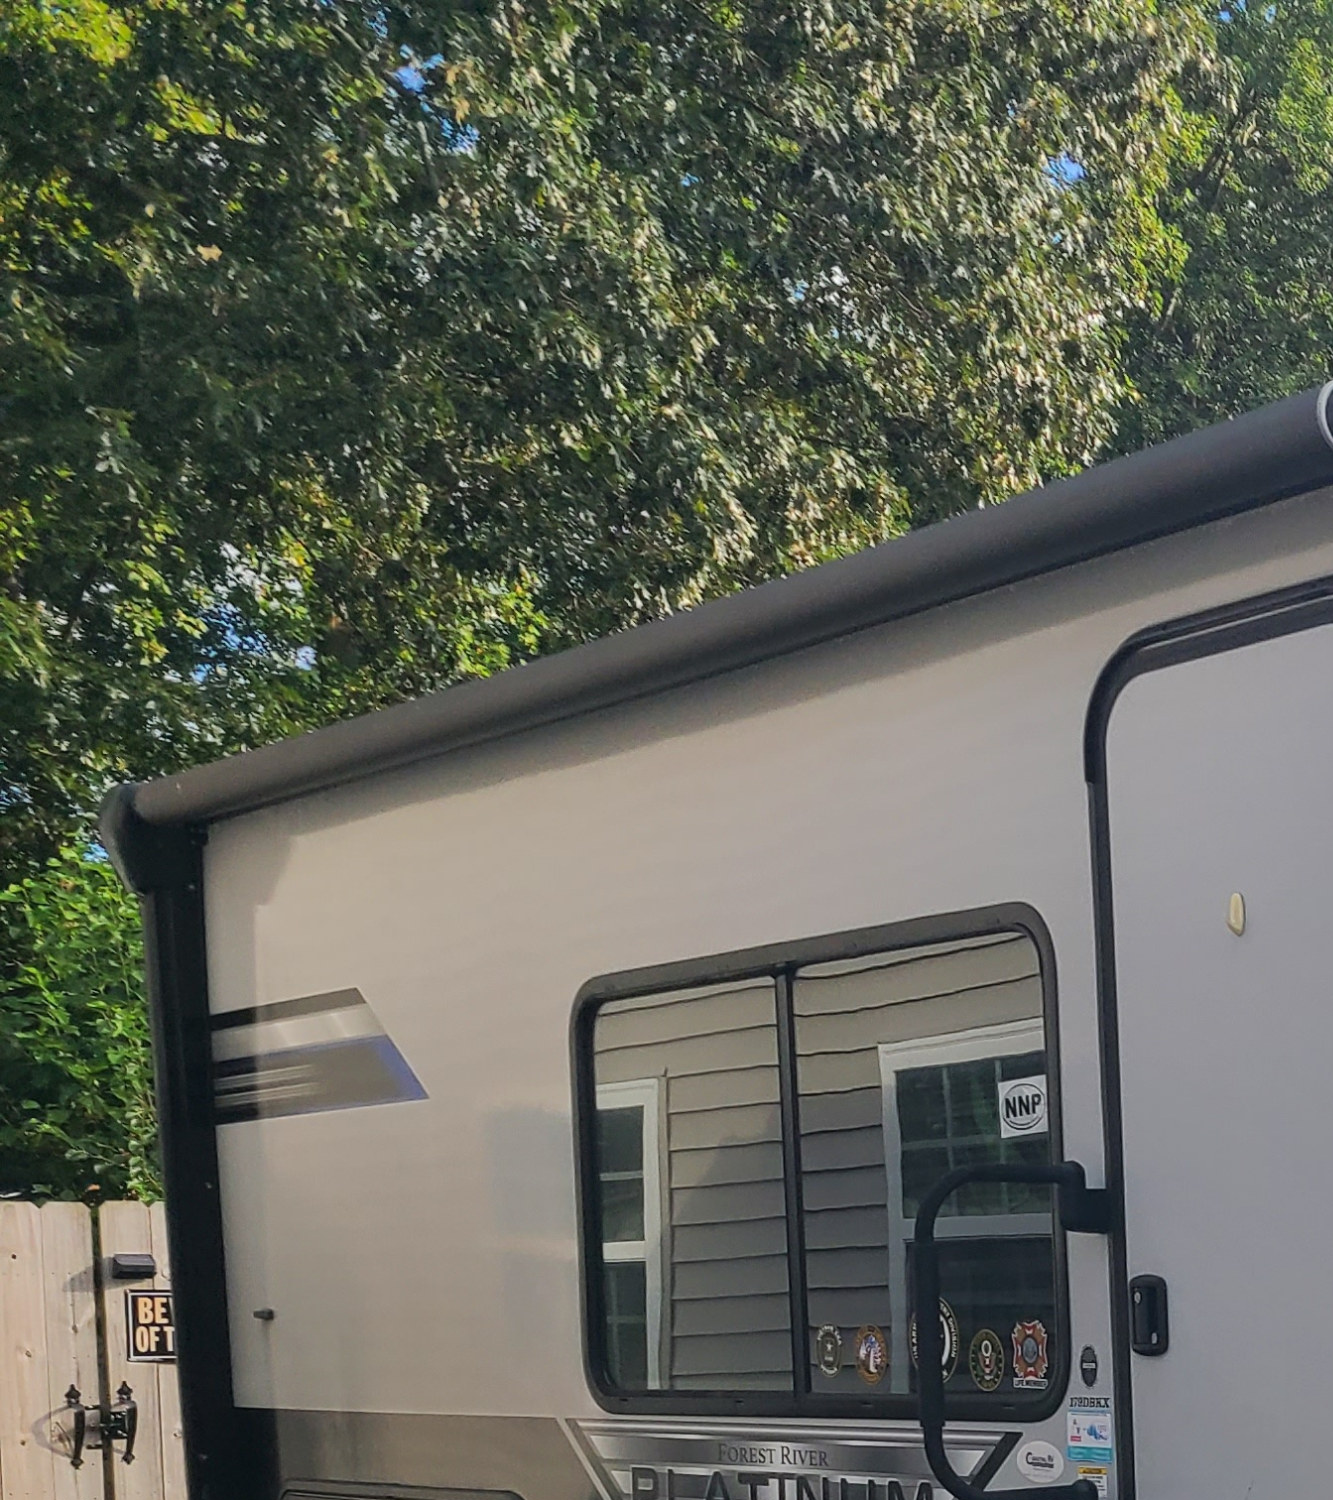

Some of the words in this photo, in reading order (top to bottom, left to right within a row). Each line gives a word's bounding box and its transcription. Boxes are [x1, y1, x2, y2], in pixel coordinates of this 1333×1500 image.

[1005, 1093, 1042, 1119] NNP
[137, 1296, 175, 1324] BE
[135, 1325, 160, 1353] OF
[718, 1443, 776, 1464] FOREST
[780, 1445, 829, 1466] RIVER
